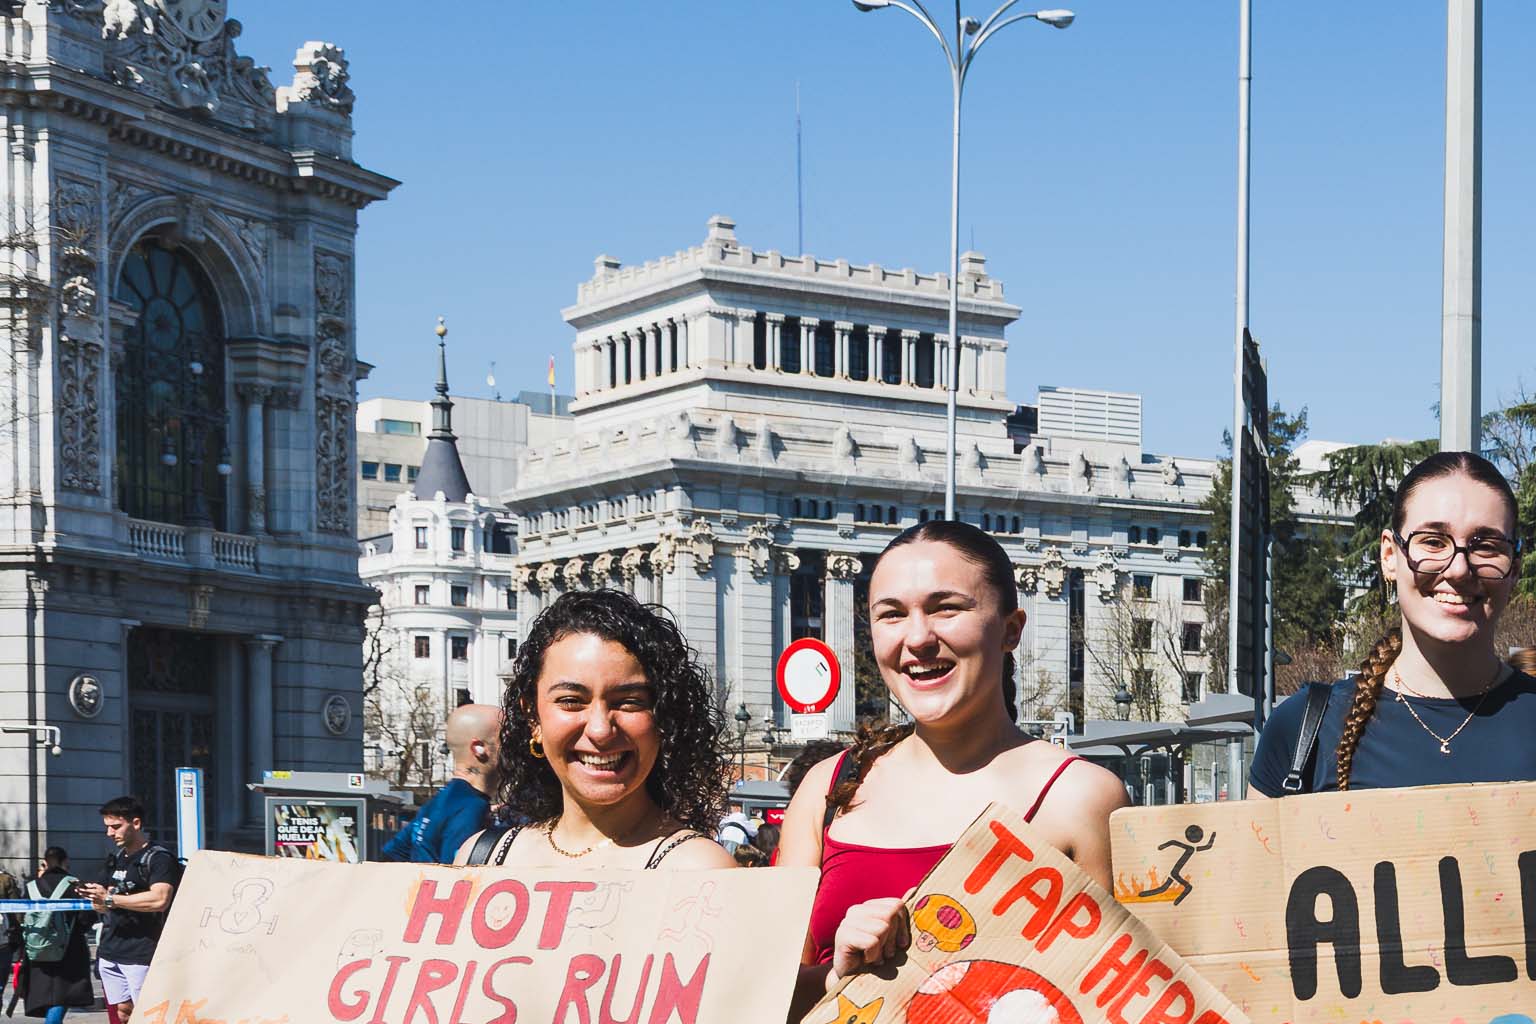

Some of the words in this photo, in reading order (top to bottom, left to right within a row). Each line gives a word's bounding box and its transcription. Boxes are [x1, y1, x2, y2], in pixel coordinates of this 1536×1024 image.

[278, 826, 298, 834] QUE
[300, 826, 325, 834] DEJA
[290, 817, 319, 826] TENIS
[963, 819, 1102, 955] TAP
[403, 878, 598, 951] HOT
